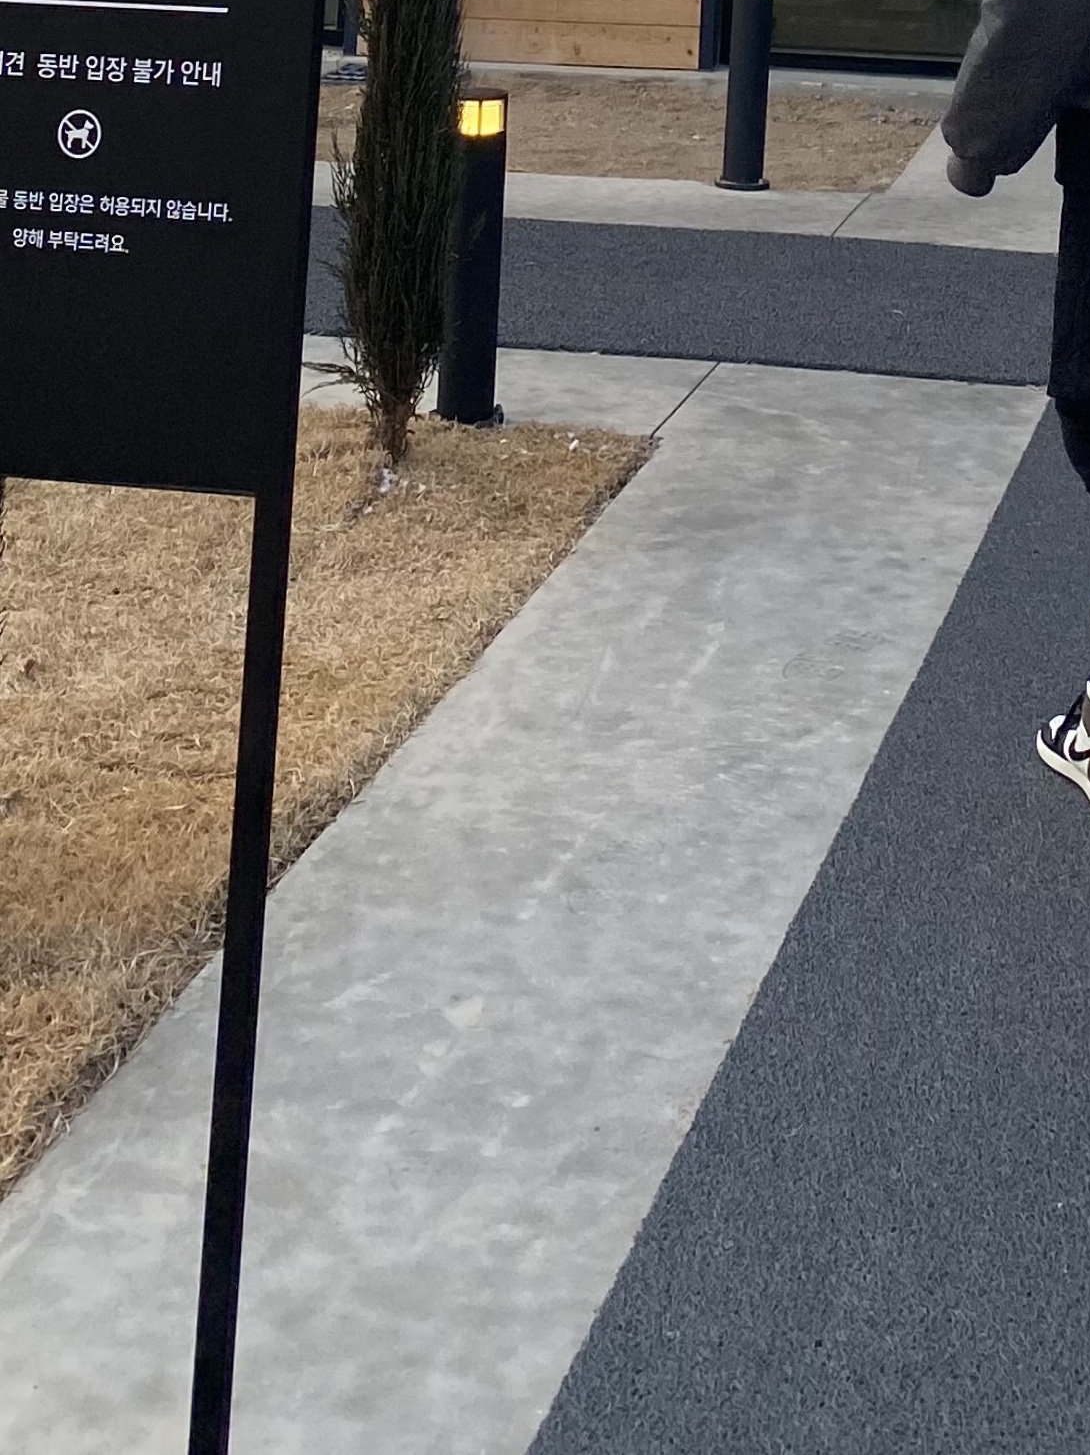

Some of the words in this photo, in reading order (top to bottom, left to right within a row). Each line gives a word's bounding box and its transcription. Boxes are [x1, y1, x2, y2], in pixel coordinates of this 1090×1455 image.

[0, 51, 24, 76] 견
[37, 54, 79, 79] 동반
[86, 56, 127, 82] 입장
[132, 58, 175, 84] 불가
[181, 61, 221, 87] 안내
[13, 191, 44, 210] 동반
[49, 193, 94, 213] 입장은
[100, 196, 161, 218] 허용되지
[166, 200, 233, 222] 않습니다.
[13, 228, 43, 248] 양해
[47, 231, 129, 253] 부탁드려요.
